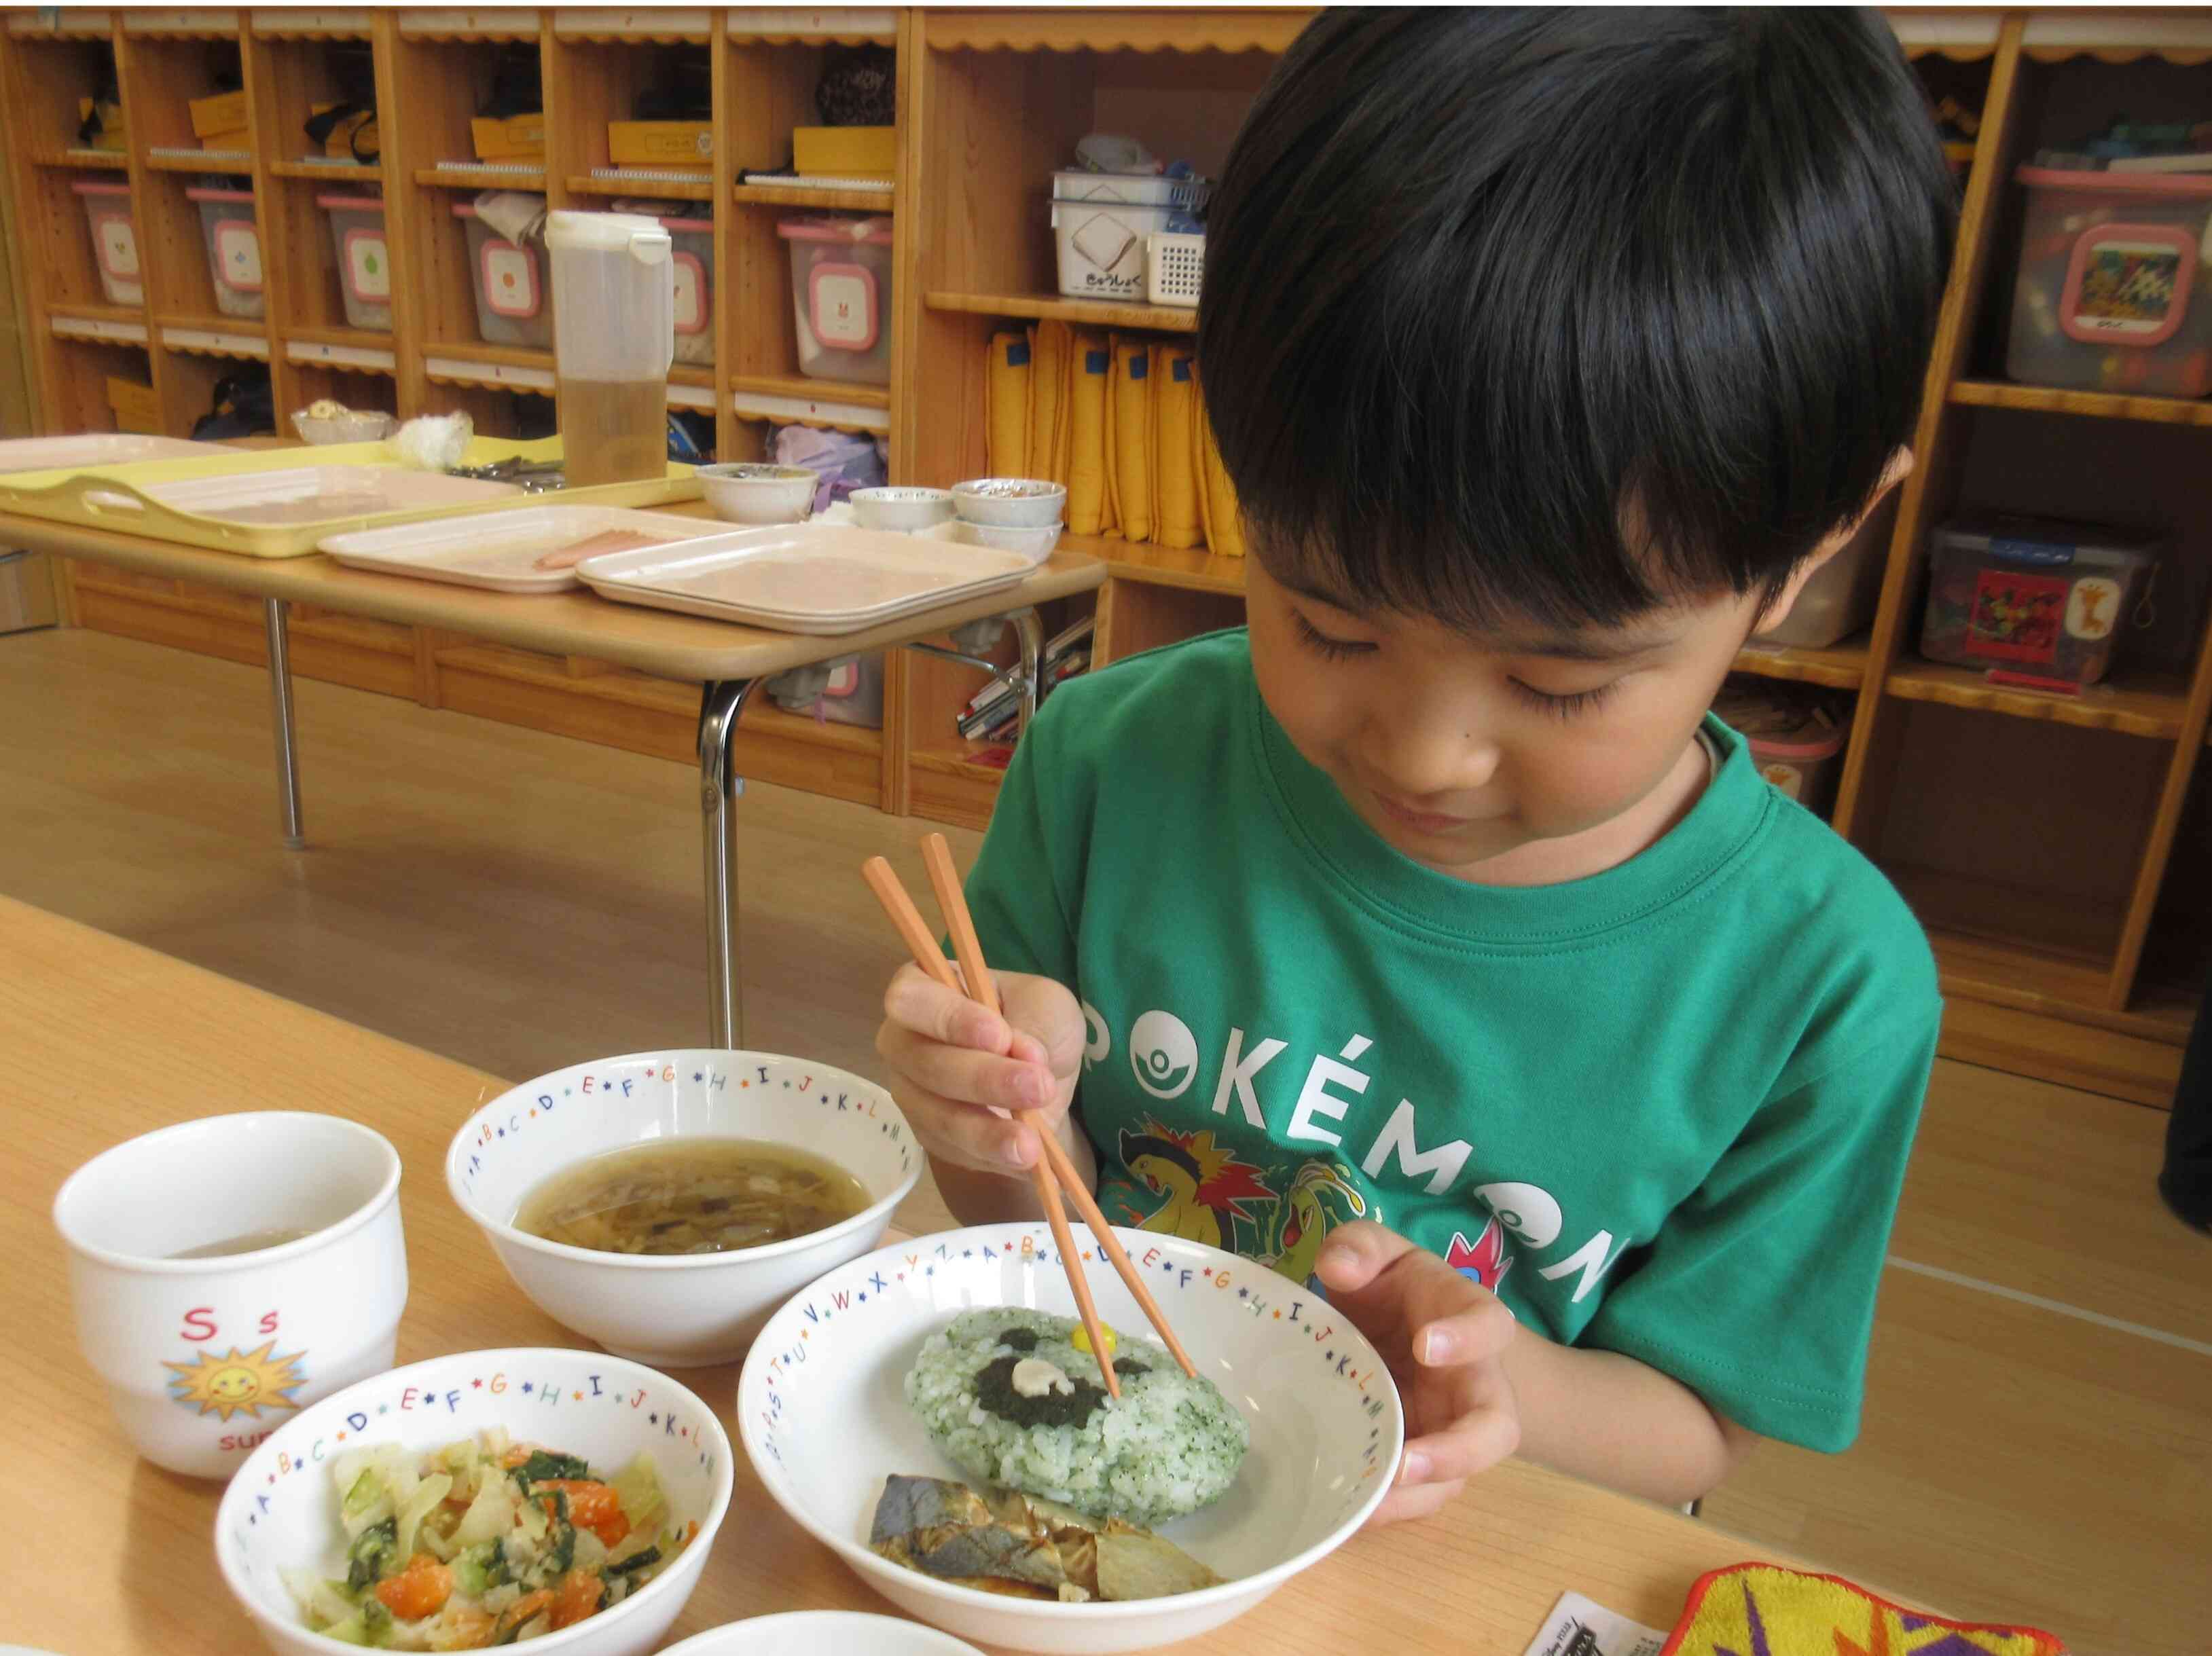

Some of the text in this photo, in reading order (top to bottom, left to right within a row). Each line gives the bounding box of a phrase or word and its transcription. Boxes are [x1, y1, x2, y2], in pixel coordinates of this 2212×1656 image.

[482, 1124, 492, 1141] B
[510, 1116, 520, 1132] C
[539, 1095, 553, 1110] D
[583, 1076, 594, 1094] E
[622, 1079, 632, 1098] F
[663, 1065, 674, 1082] G
[710, 1073, 726, 1091] H
[757, 1067, 769, 1084] I
[799, 1075, 813, 1091] J
[838, 1094, 848, 1111] K
[869, 1101, 876, 1119] L
[181, 1308, 278, 1341] S s
[771, 1357, 783, 1376] T
[793, 1342, 806, 1363] U
[804, 1303, 818, 1322] V
[831, 1289, 849, 1310] W
[869, 1271, 888, 1293] X
[905, 1255, 918, 1272] Y
[984, 1245, 998, 1265] A
[1021, 1235, 1034, 1255] B
[1142, 1247, 1161, 1268] E
[1180, 1269, 1193, 1289] F
[1215, 1270, 1231, 1289] G
[1289, 1302, 1303, 1321] I
[1315, 1326, 1332, 1342] J
[1335, 1355, 1352, 1376] K
[1359, 1370, 1374, 1391] L
[278, 1452, 291, 1474] B
[312, 1439, 325, 1460] C
[347, 1413, 367, 1431] D
[401, 1388, 418, 1410] E
[446, 1390, 460, 1413] F
[490, 1374, 507, 1395] G
[540, 1383, 560, 1405] H
[589, 1375, 602, 1396] I
[631, 1389, 647, 1408] J
[666, 1413, 676, 1435] K
[691, 1423, 700, 1448] L
